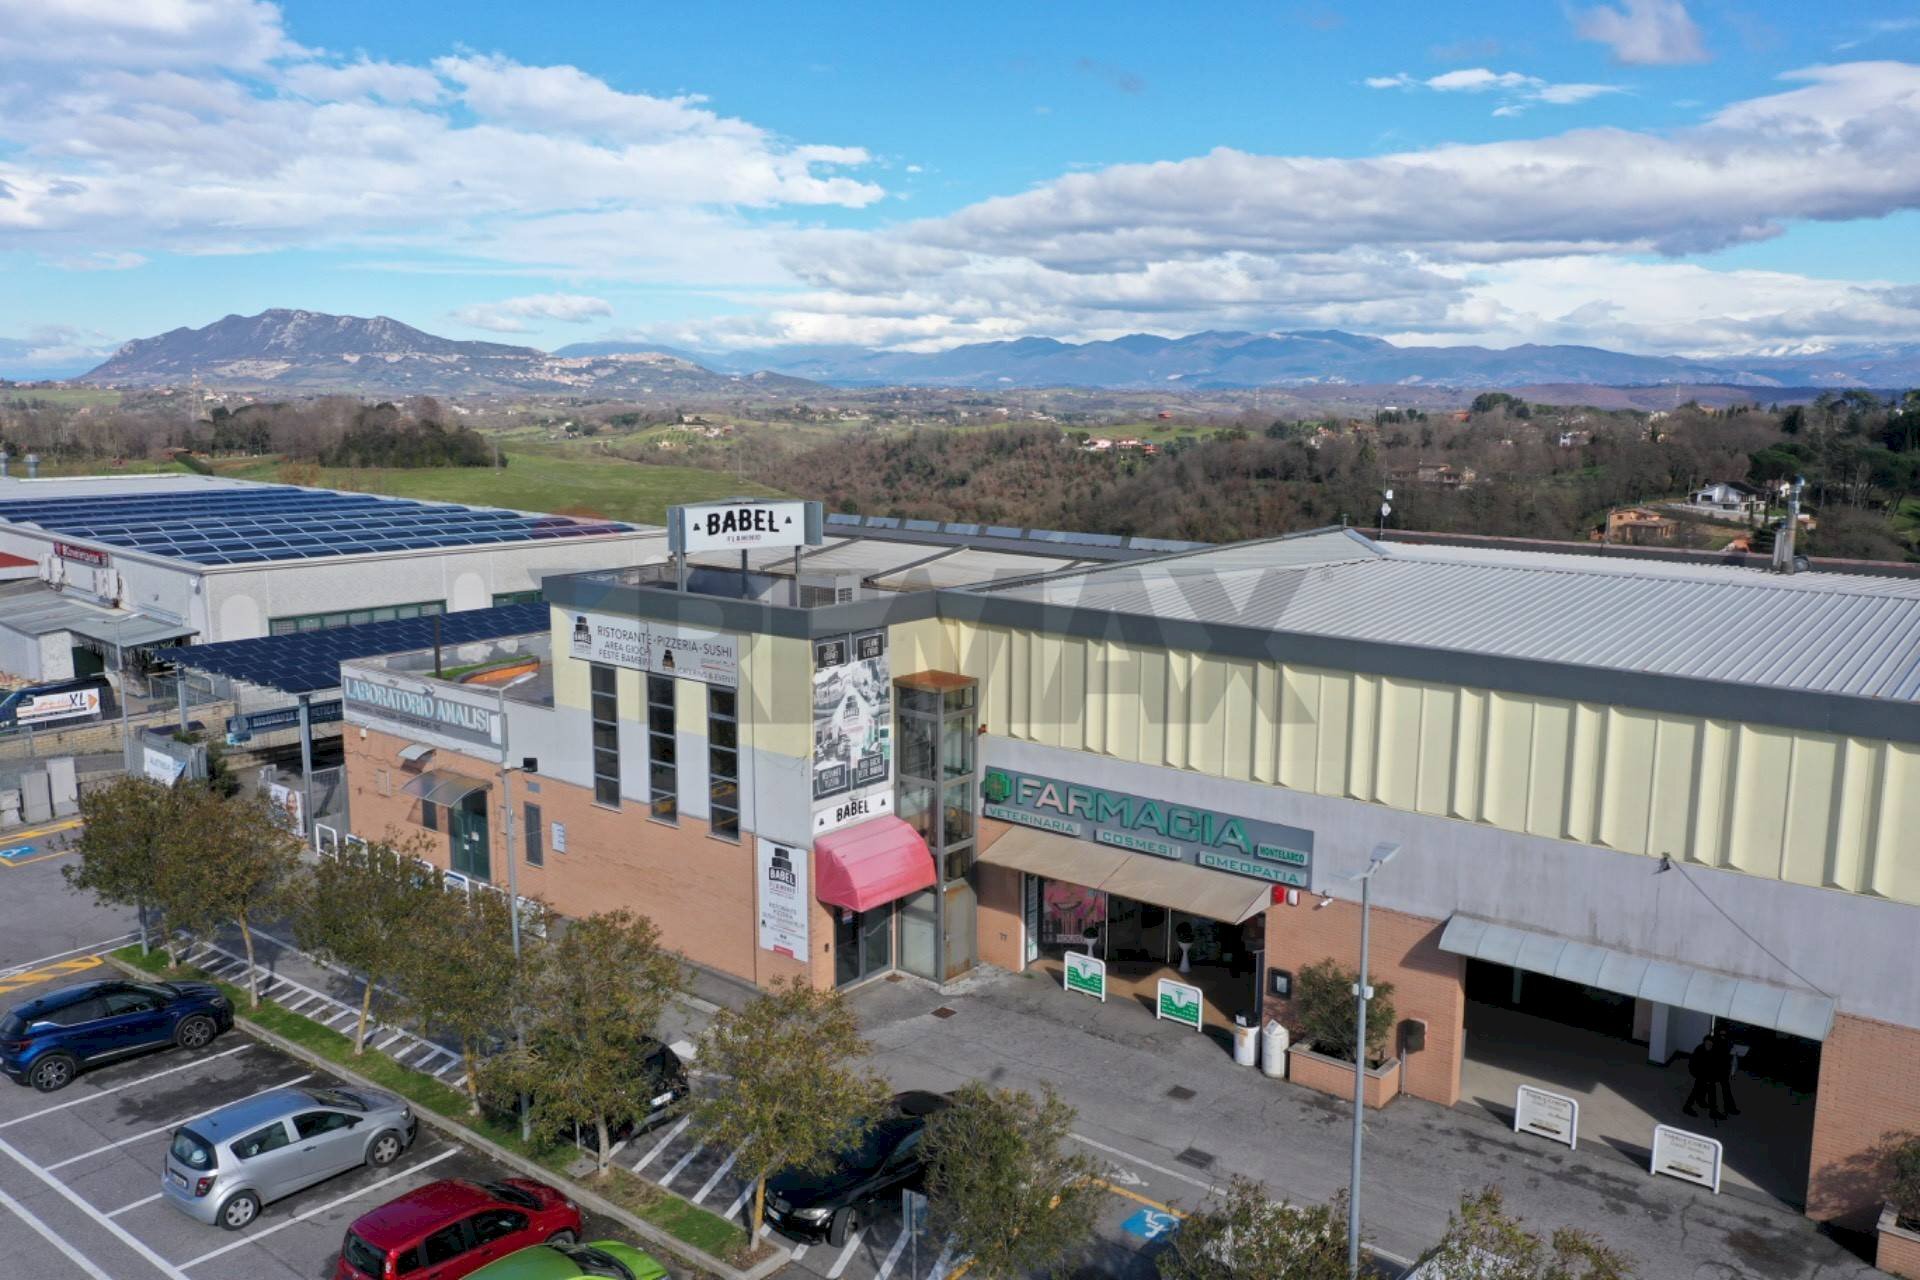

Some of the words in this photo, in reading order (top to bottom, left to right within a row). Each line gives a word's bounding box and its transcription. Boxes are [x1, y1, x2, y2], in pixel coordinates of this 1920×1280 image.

[707, 508, 780, 536] BABEL
[597, 625, 652, 645] RISTORANTE
[657, 635, 698, 653] PIZZERIA
[703, 642, 732, 658] SUSHI
[69, 692, 86, 706] XL
[345, 678, 434, 718] LABORATORIO
[436, 700, 489, 731] ANALISI
[836, 800, 869, 822] BABEL
[988, 806, 1075, 834] VETERINARIA
[1015, 776, 1253, 855] FARMACIA
[1102, 831, 1175, 856] COSMESI
[769, 868, 796, 886] BABEL
[1204, 854, 1300, 885] OMEOPATIA
